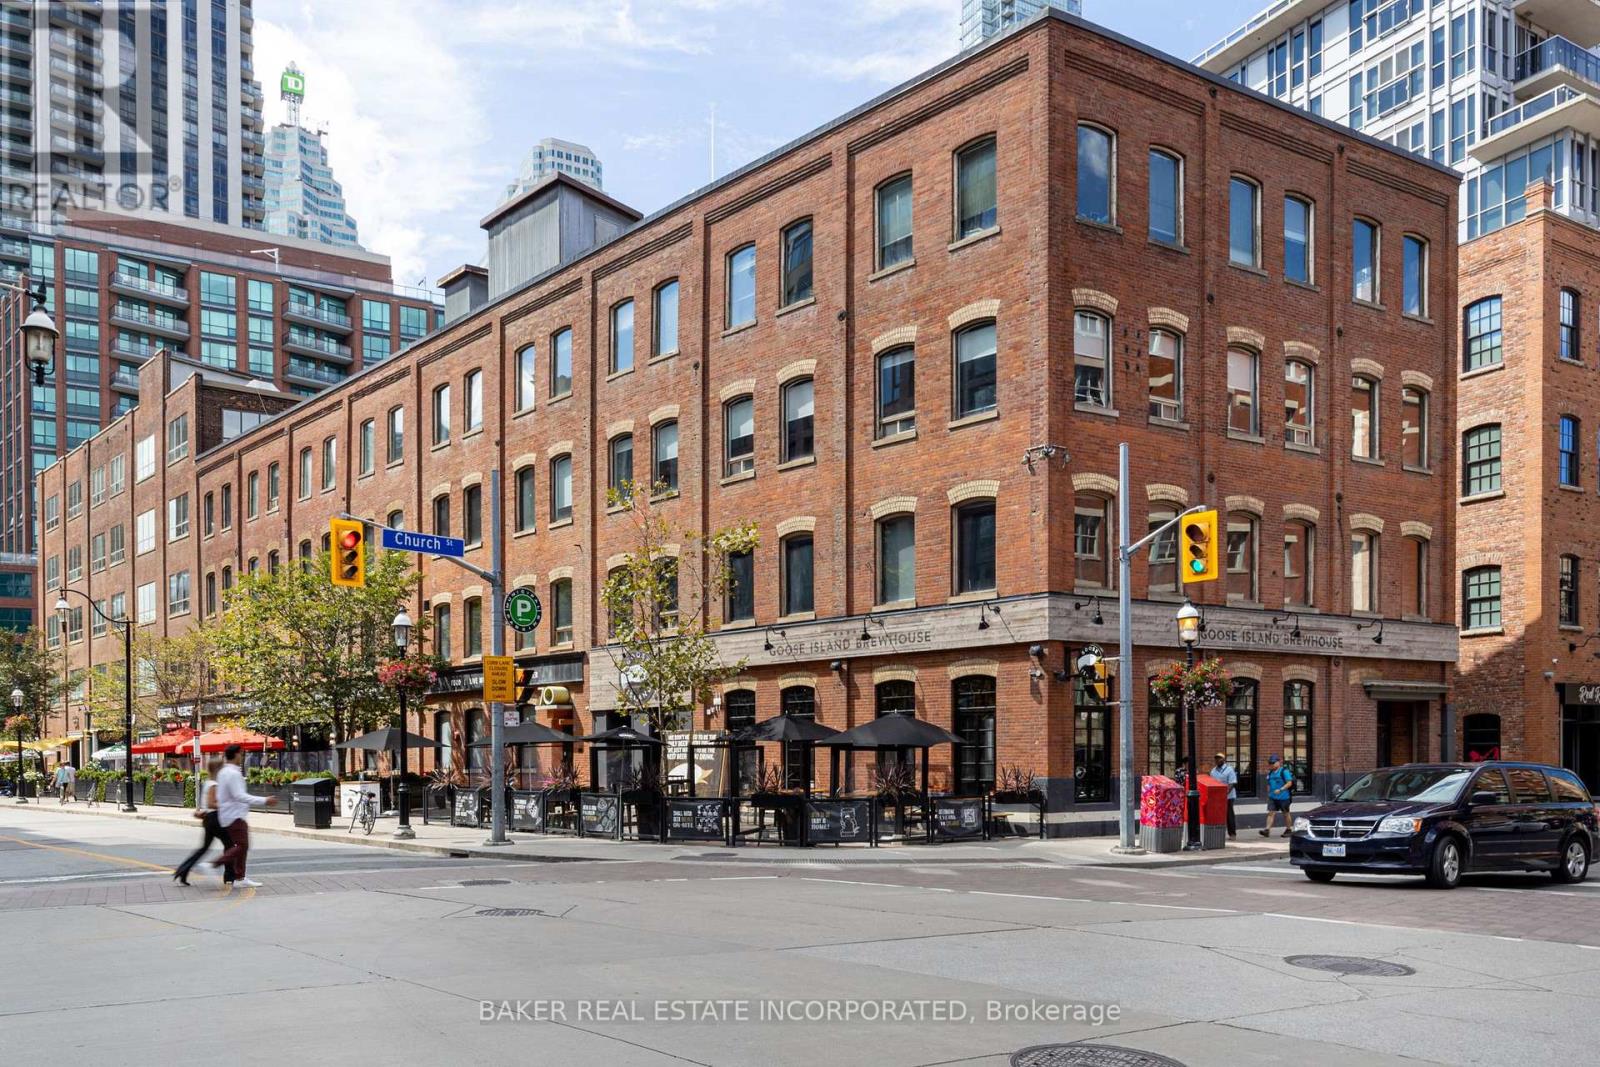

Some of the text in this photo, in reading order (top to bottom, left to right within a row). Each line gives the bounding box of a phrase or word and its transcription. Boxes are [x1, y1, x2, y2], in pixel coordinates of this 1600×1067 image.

[284, 75, 303, 91] TD
[395, 532, 453, 550] Church St
[516, 599, 532, 617] P
[769, 631, 932, 657] GOOSE ISLAND BREWHOUSE
[1200, 628, 1343, 649] GOOSE ISLAND BREWHOUSE
[1579, 685, 1595, 703] Red
